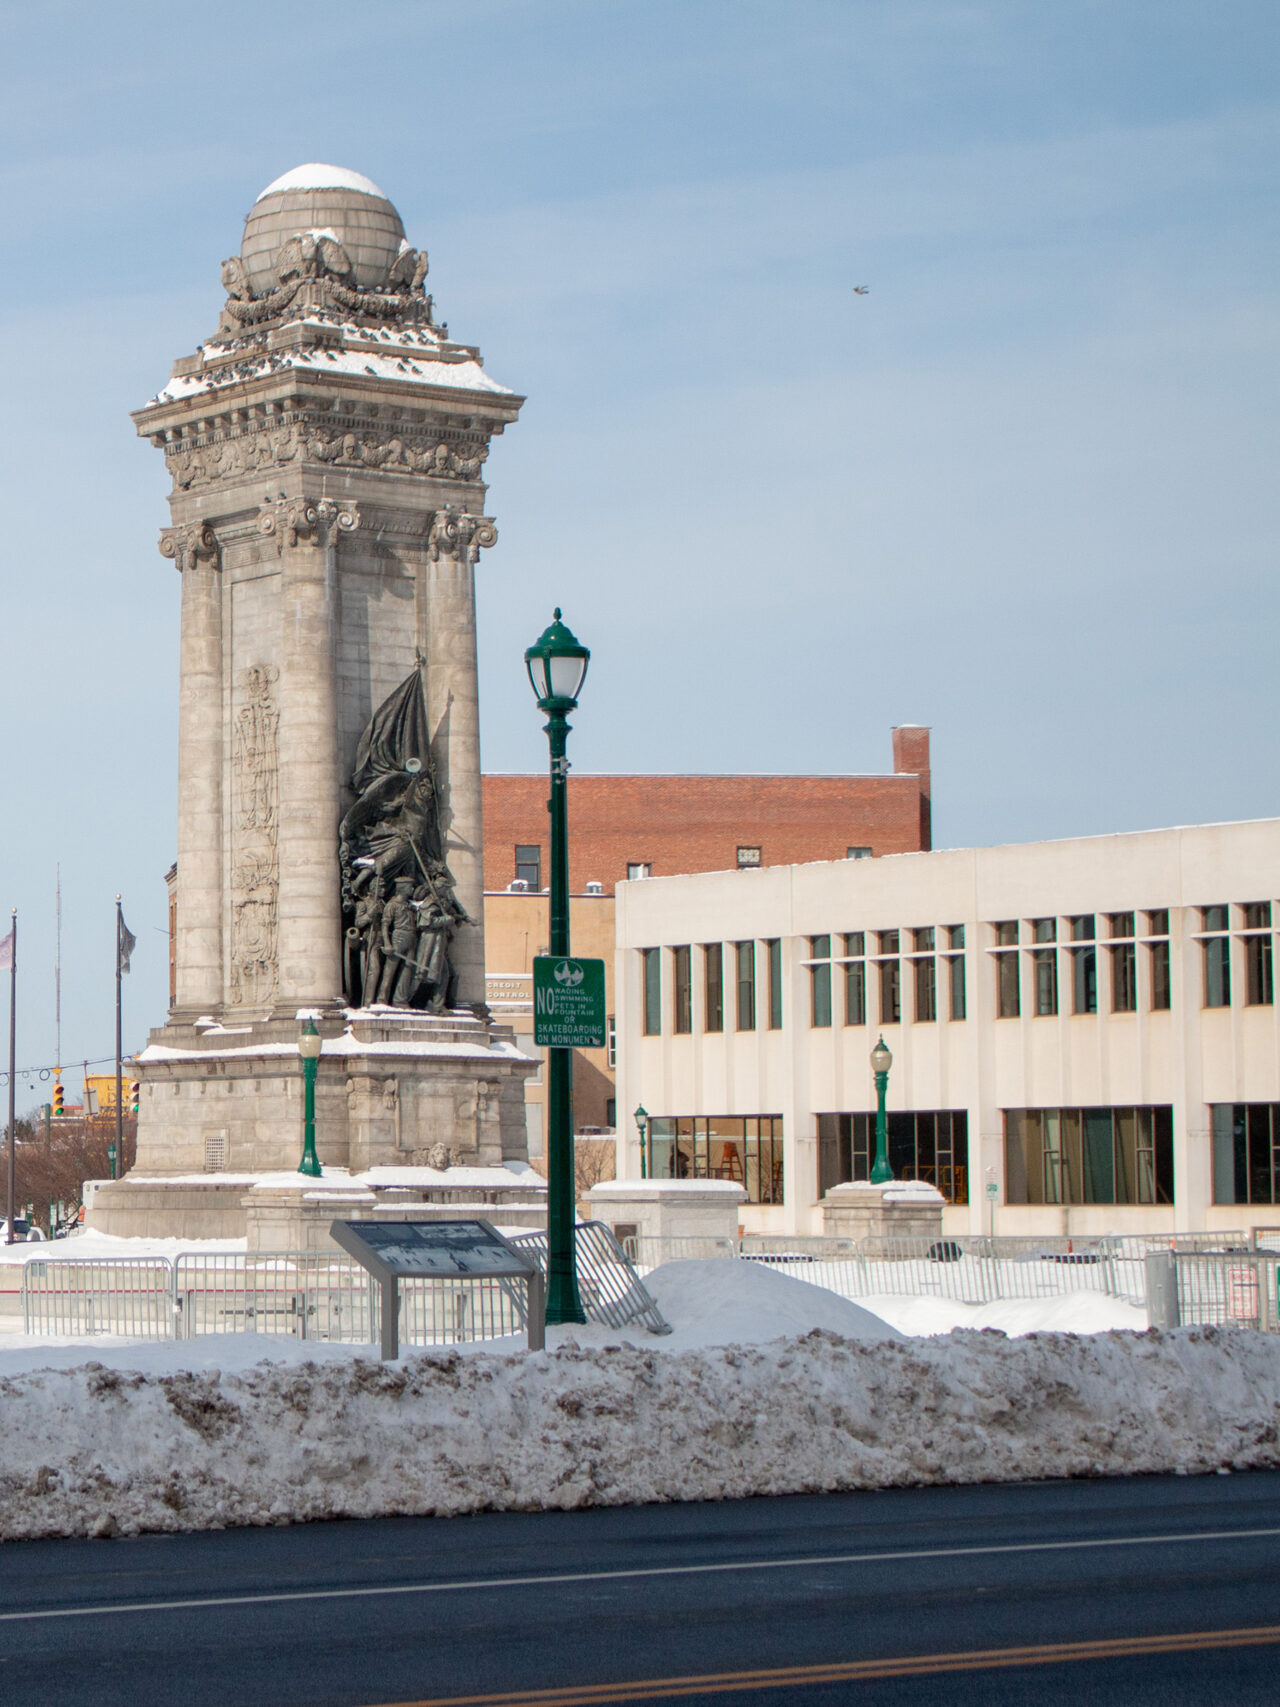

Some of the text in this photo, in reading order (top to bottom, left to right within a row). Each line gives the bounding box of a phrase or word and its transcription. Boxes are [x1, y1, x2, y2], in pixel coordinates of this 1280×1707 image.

[537, 987, 555, 1015] NO
[564, 1016, 575, 1024] OR
[537, 1024, 603, 1035] SKATEBOARDING
[537, 1034, 600, 1045] ON MONUMEN
